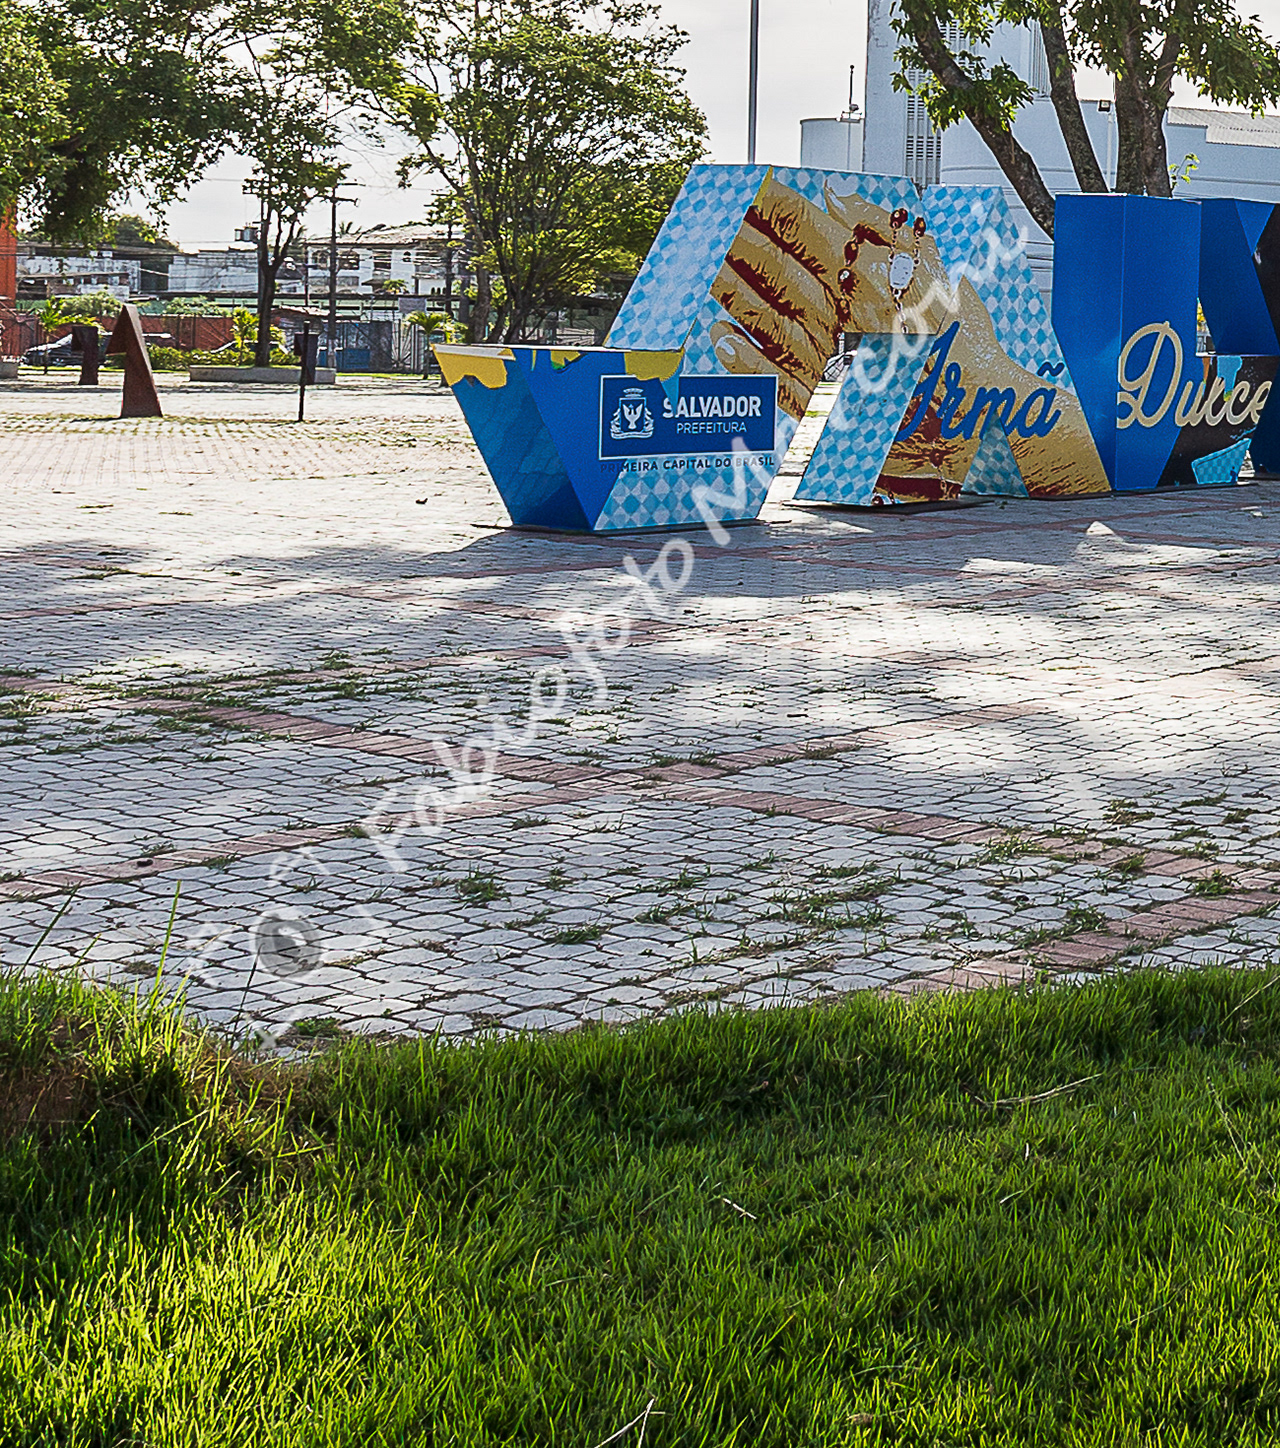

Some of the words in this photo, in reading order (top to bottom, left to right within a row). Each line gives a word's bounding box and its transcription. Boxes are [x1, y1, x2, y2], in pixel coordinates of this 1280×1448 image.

[895, 321, 1064, 442] Irmã
[1116, 321, 1273, 430] Dulce
[662, 395, 762, 419] SALVADOR
[676, 421, 747, 434] PREFEITURA
[600, 461, 659, 474] PRIMEIRA
[662, 458, 711, 470] CAPITAL
[715, 457, 732, 468] DO
[735, 456, 775, 467] BRASIL
